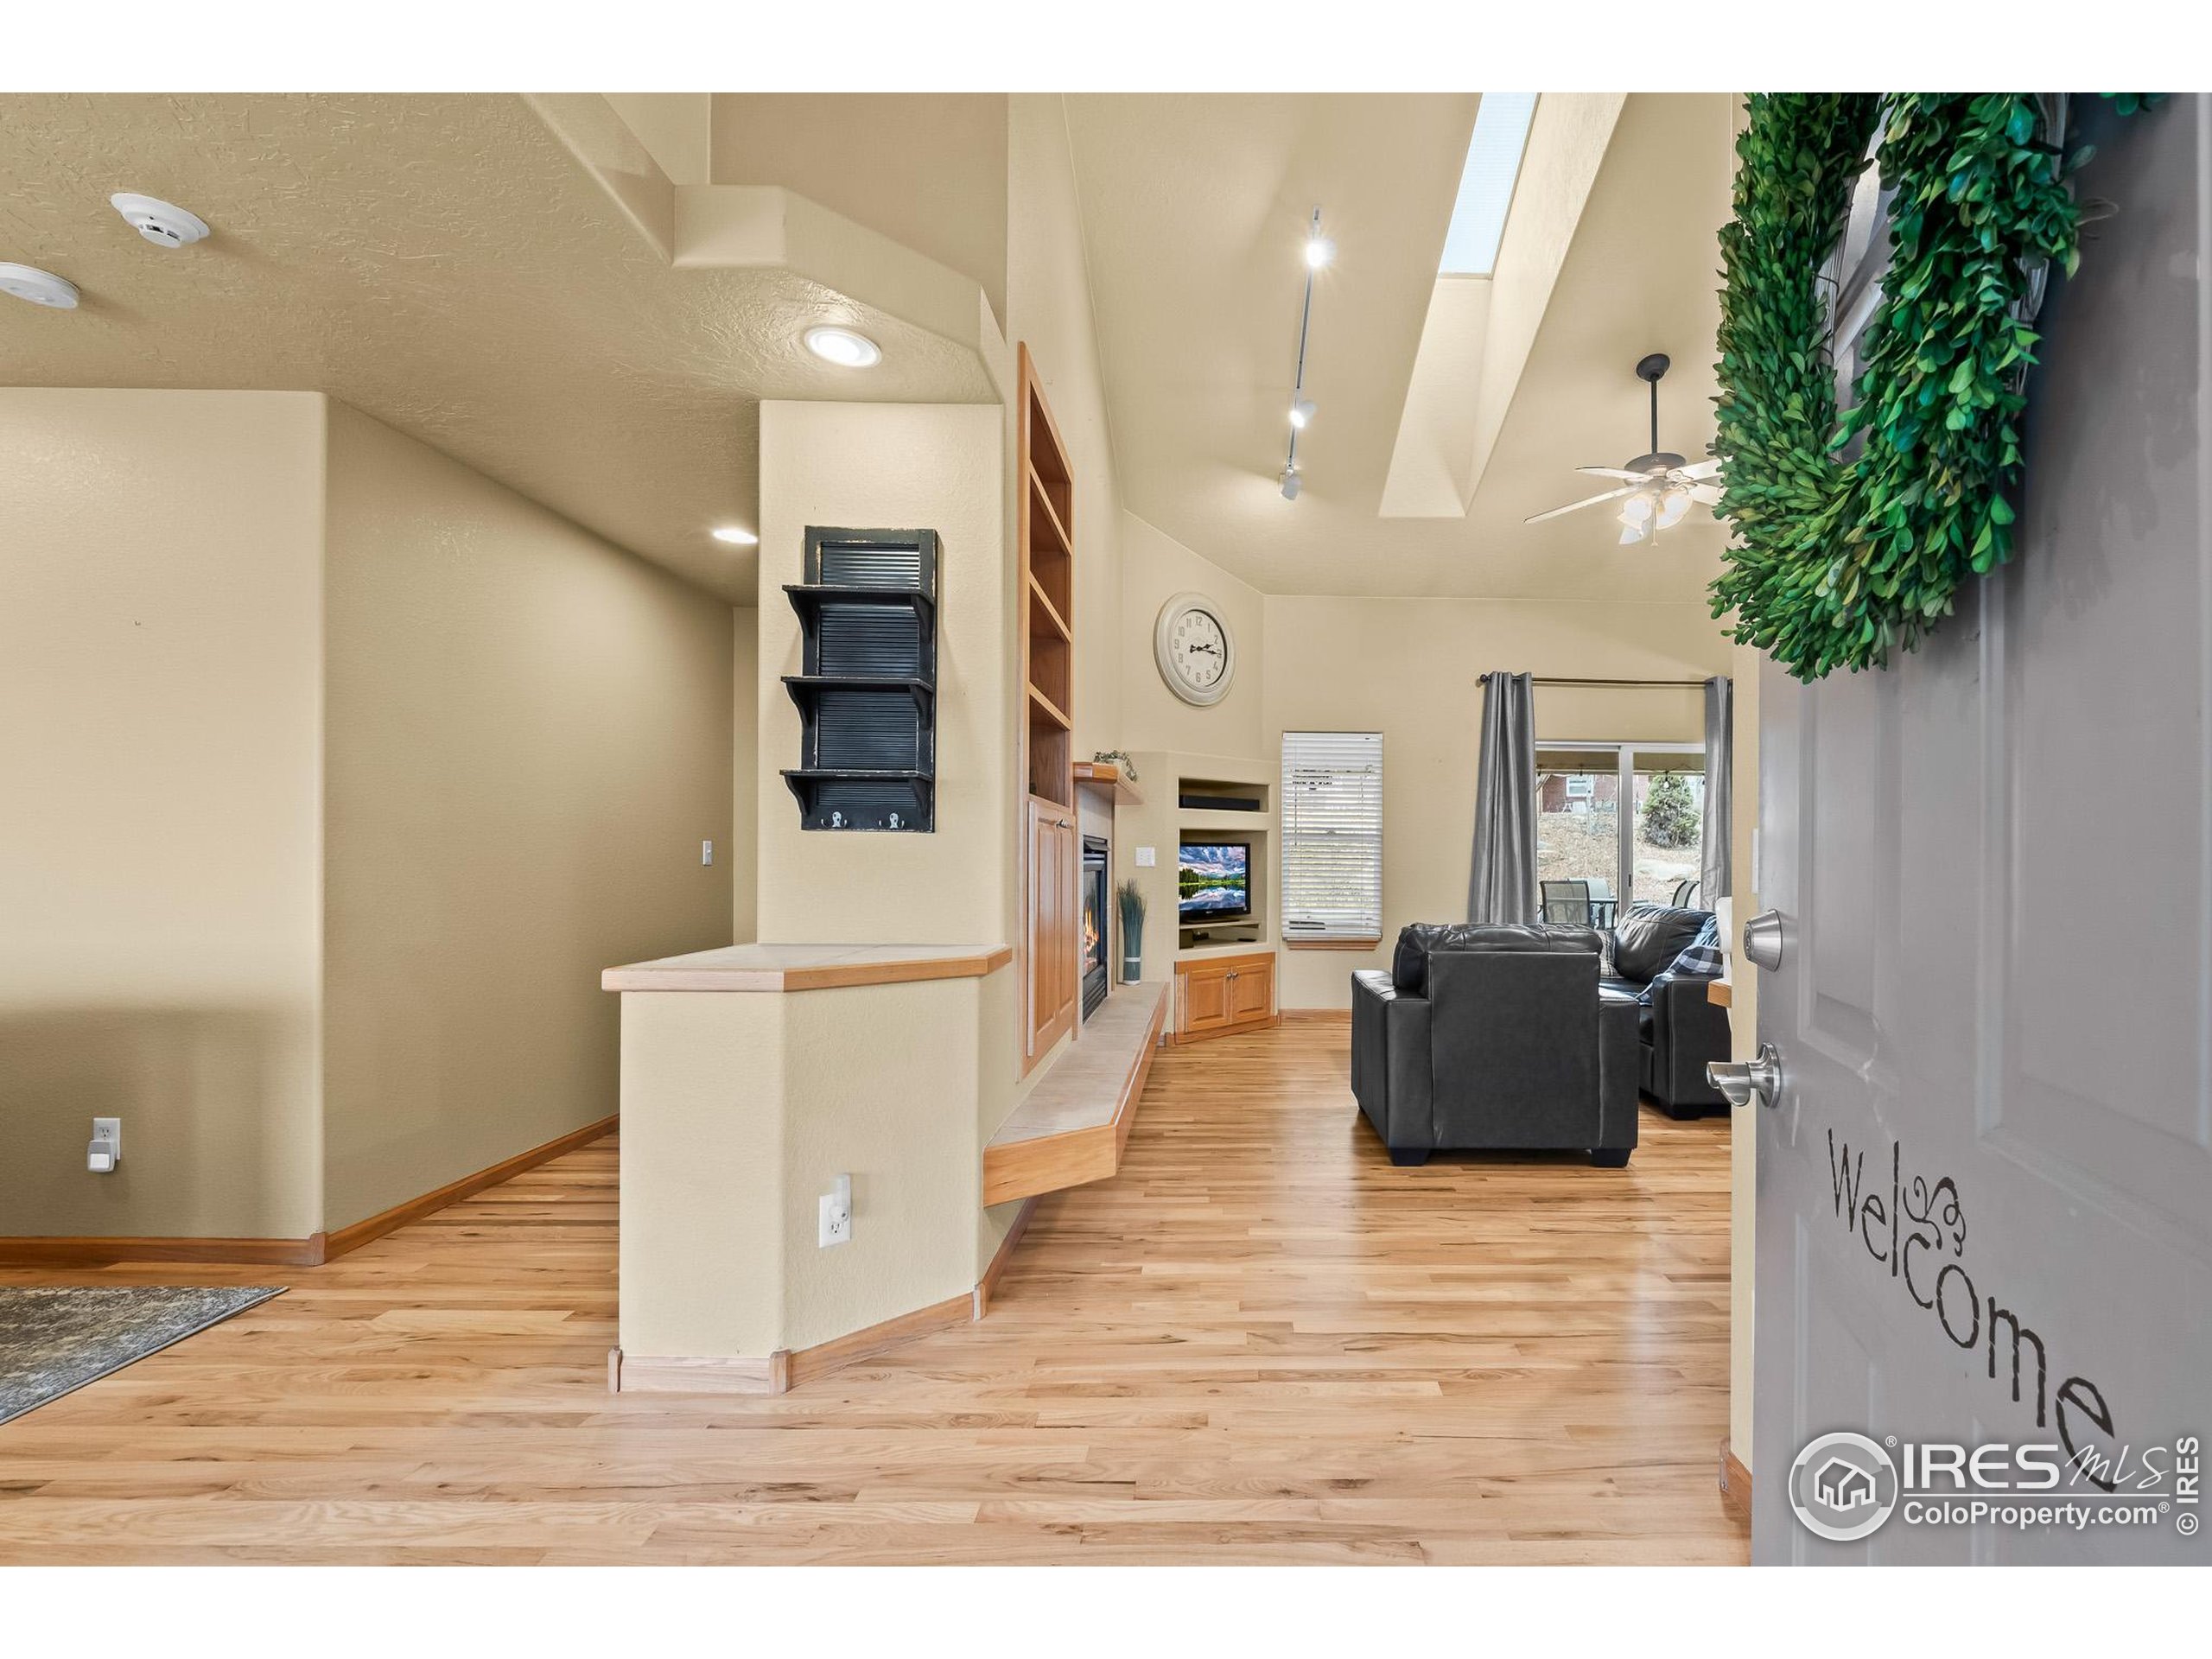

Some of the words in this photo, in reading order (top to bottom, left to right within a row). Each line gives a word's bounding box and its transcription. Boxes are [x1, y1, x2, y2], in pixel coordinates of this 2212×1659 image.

[1186, 618, 1192, 629] 11
[1196, 616, 1203, 626] 12
[1178, 626, 1185, 637] 10
[1827, 1128, 2116, 1493] Welcome
